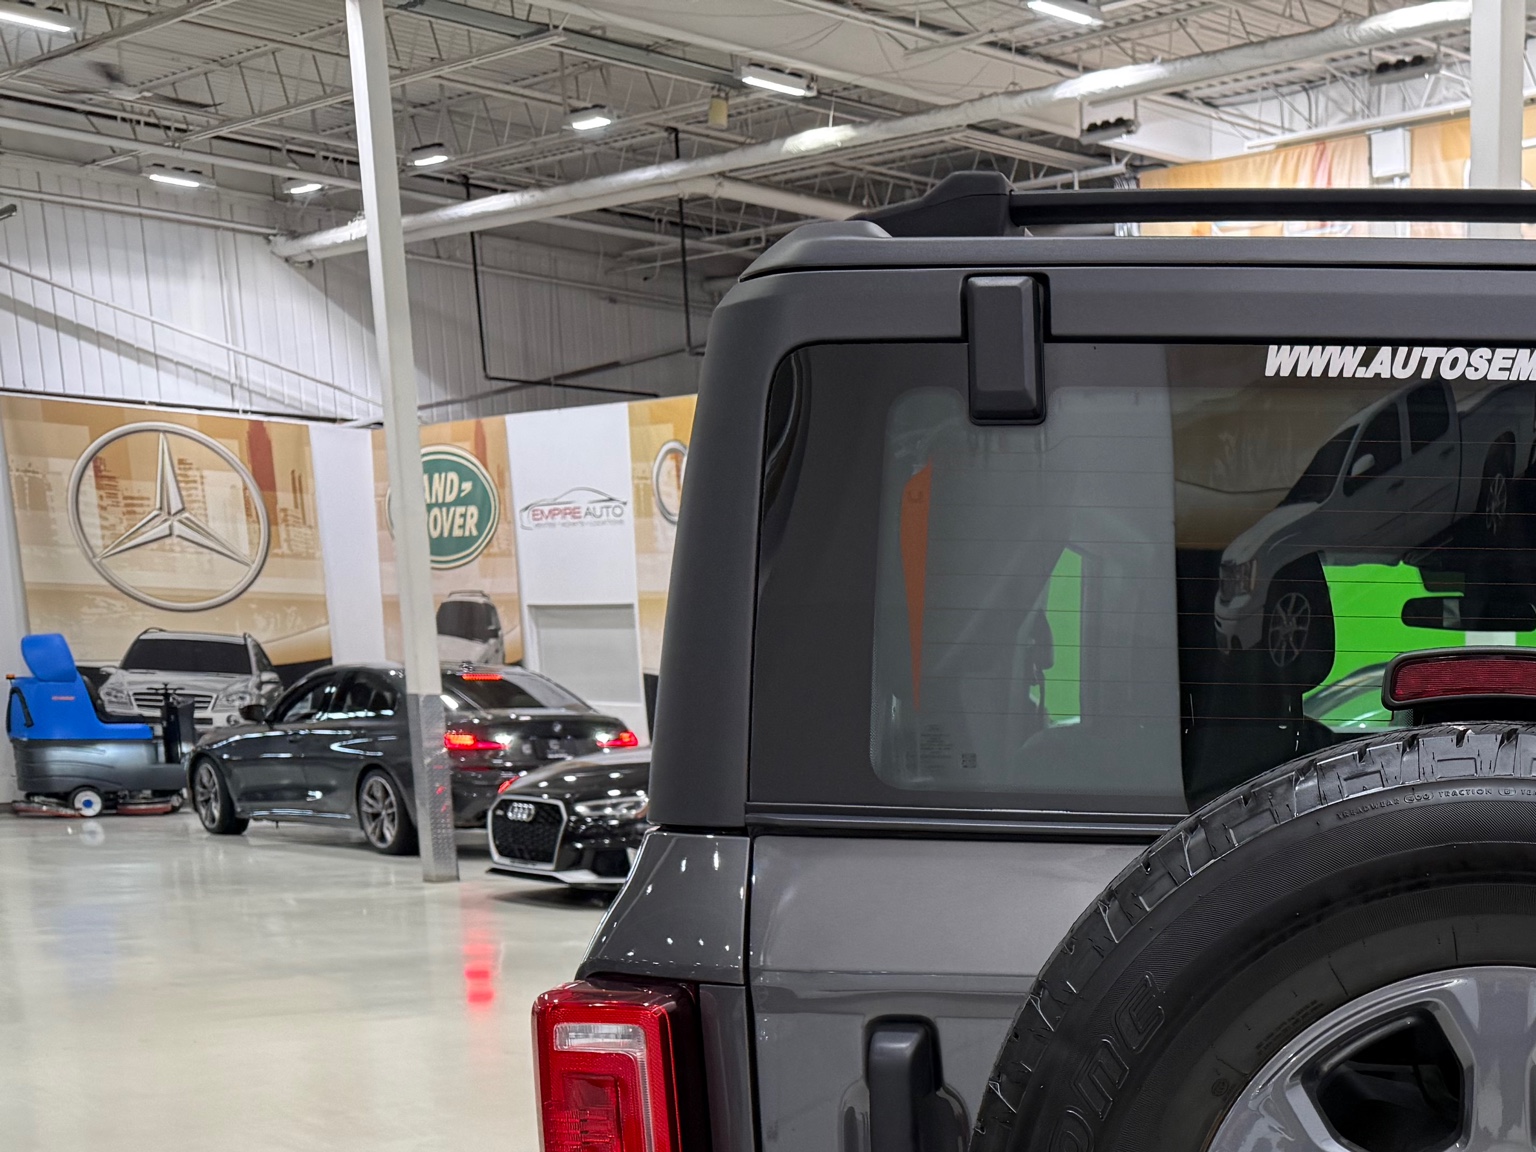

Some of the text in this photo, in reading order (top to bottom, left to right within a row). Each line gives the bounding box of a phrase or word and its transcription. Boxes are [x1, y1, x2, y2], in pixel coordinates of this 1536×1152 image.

[584, 503, 625, 519] AUTO
[428, 505, 479, 539] OVER
[1437, 787, 1494, 799] TRACTION
